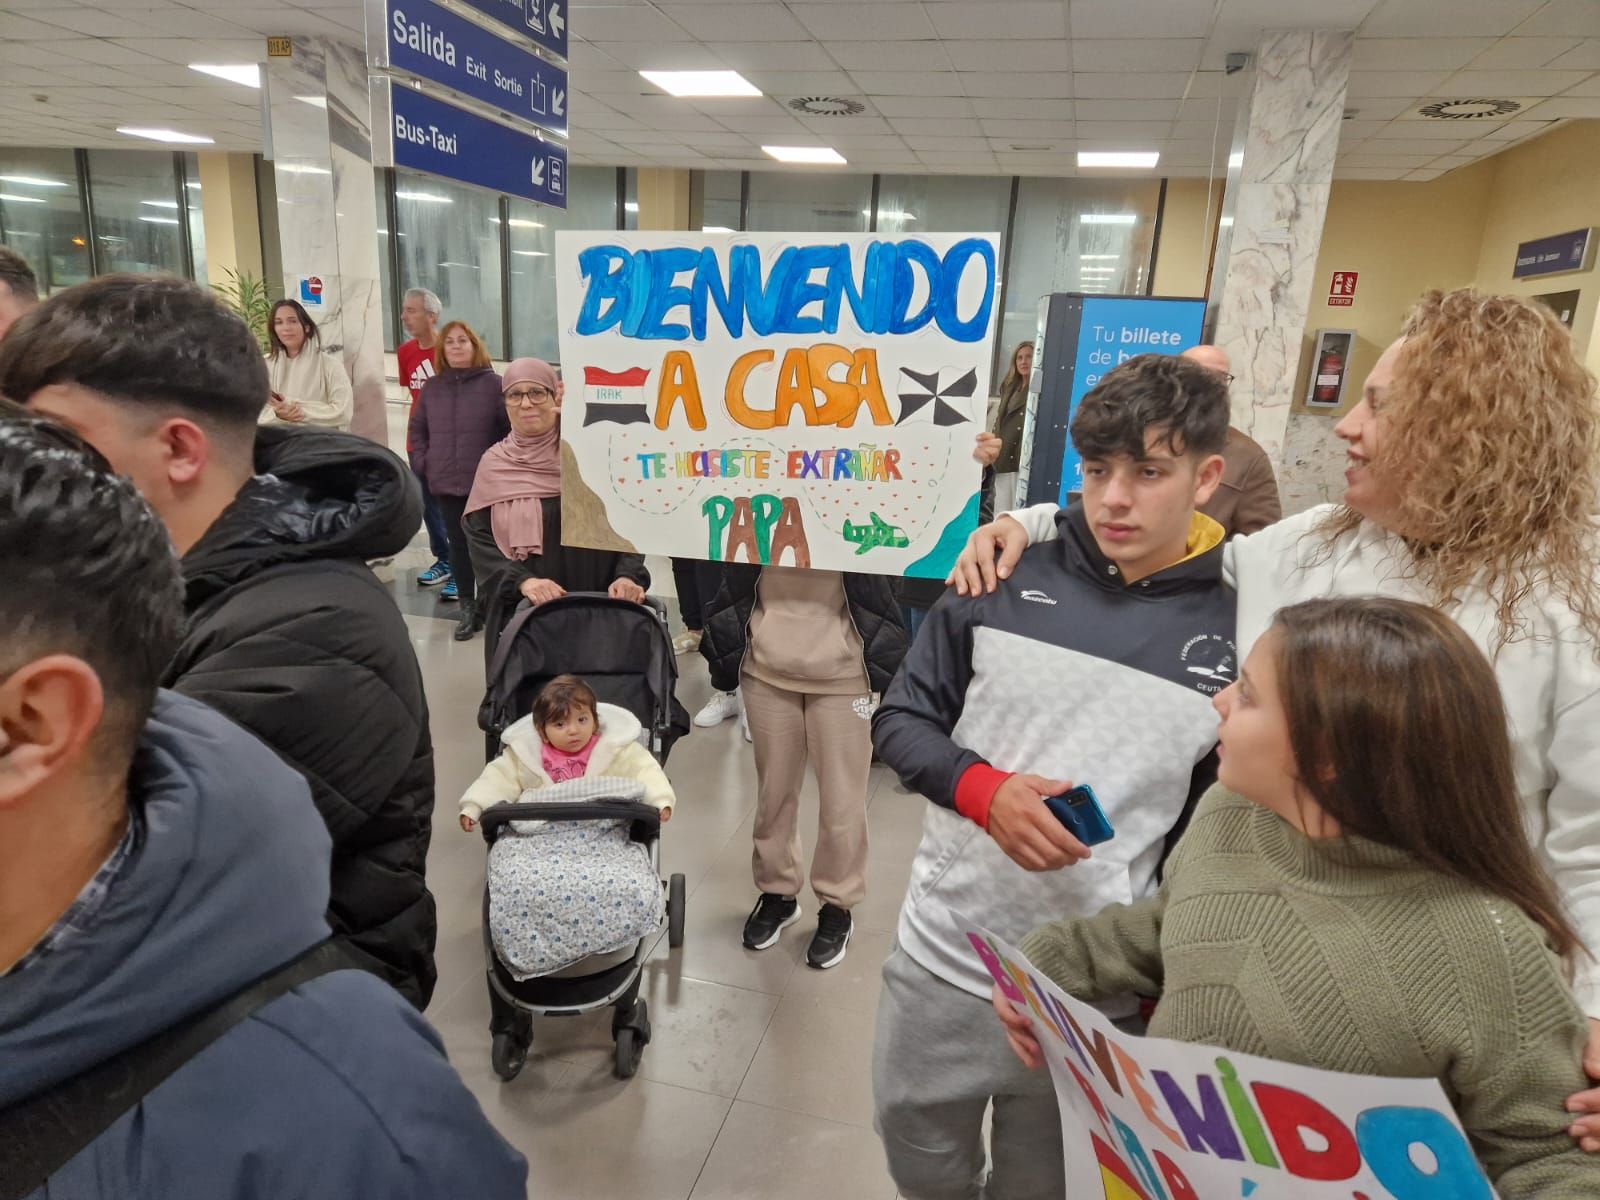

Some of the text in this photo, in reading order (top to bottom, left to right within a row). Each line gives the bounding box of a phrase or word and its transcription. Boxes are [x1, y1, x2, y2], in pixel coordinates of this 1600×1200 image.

[393, 10, 523, 97] Salida Exit Sortie
[395, 114, 457, 155] Bus-Taxi
[1093, 326, 1182, 346] Tu billete
[1089, 349, 1112, 365] de
[596, 388, 622, 400] IRAK
[654, 343, 894, 431] A CASA
[636, 452, 667, 479] TE
[786, 443, 903, 482] EXTRAÑAR
[702, 494, 811, 568] PAPA
